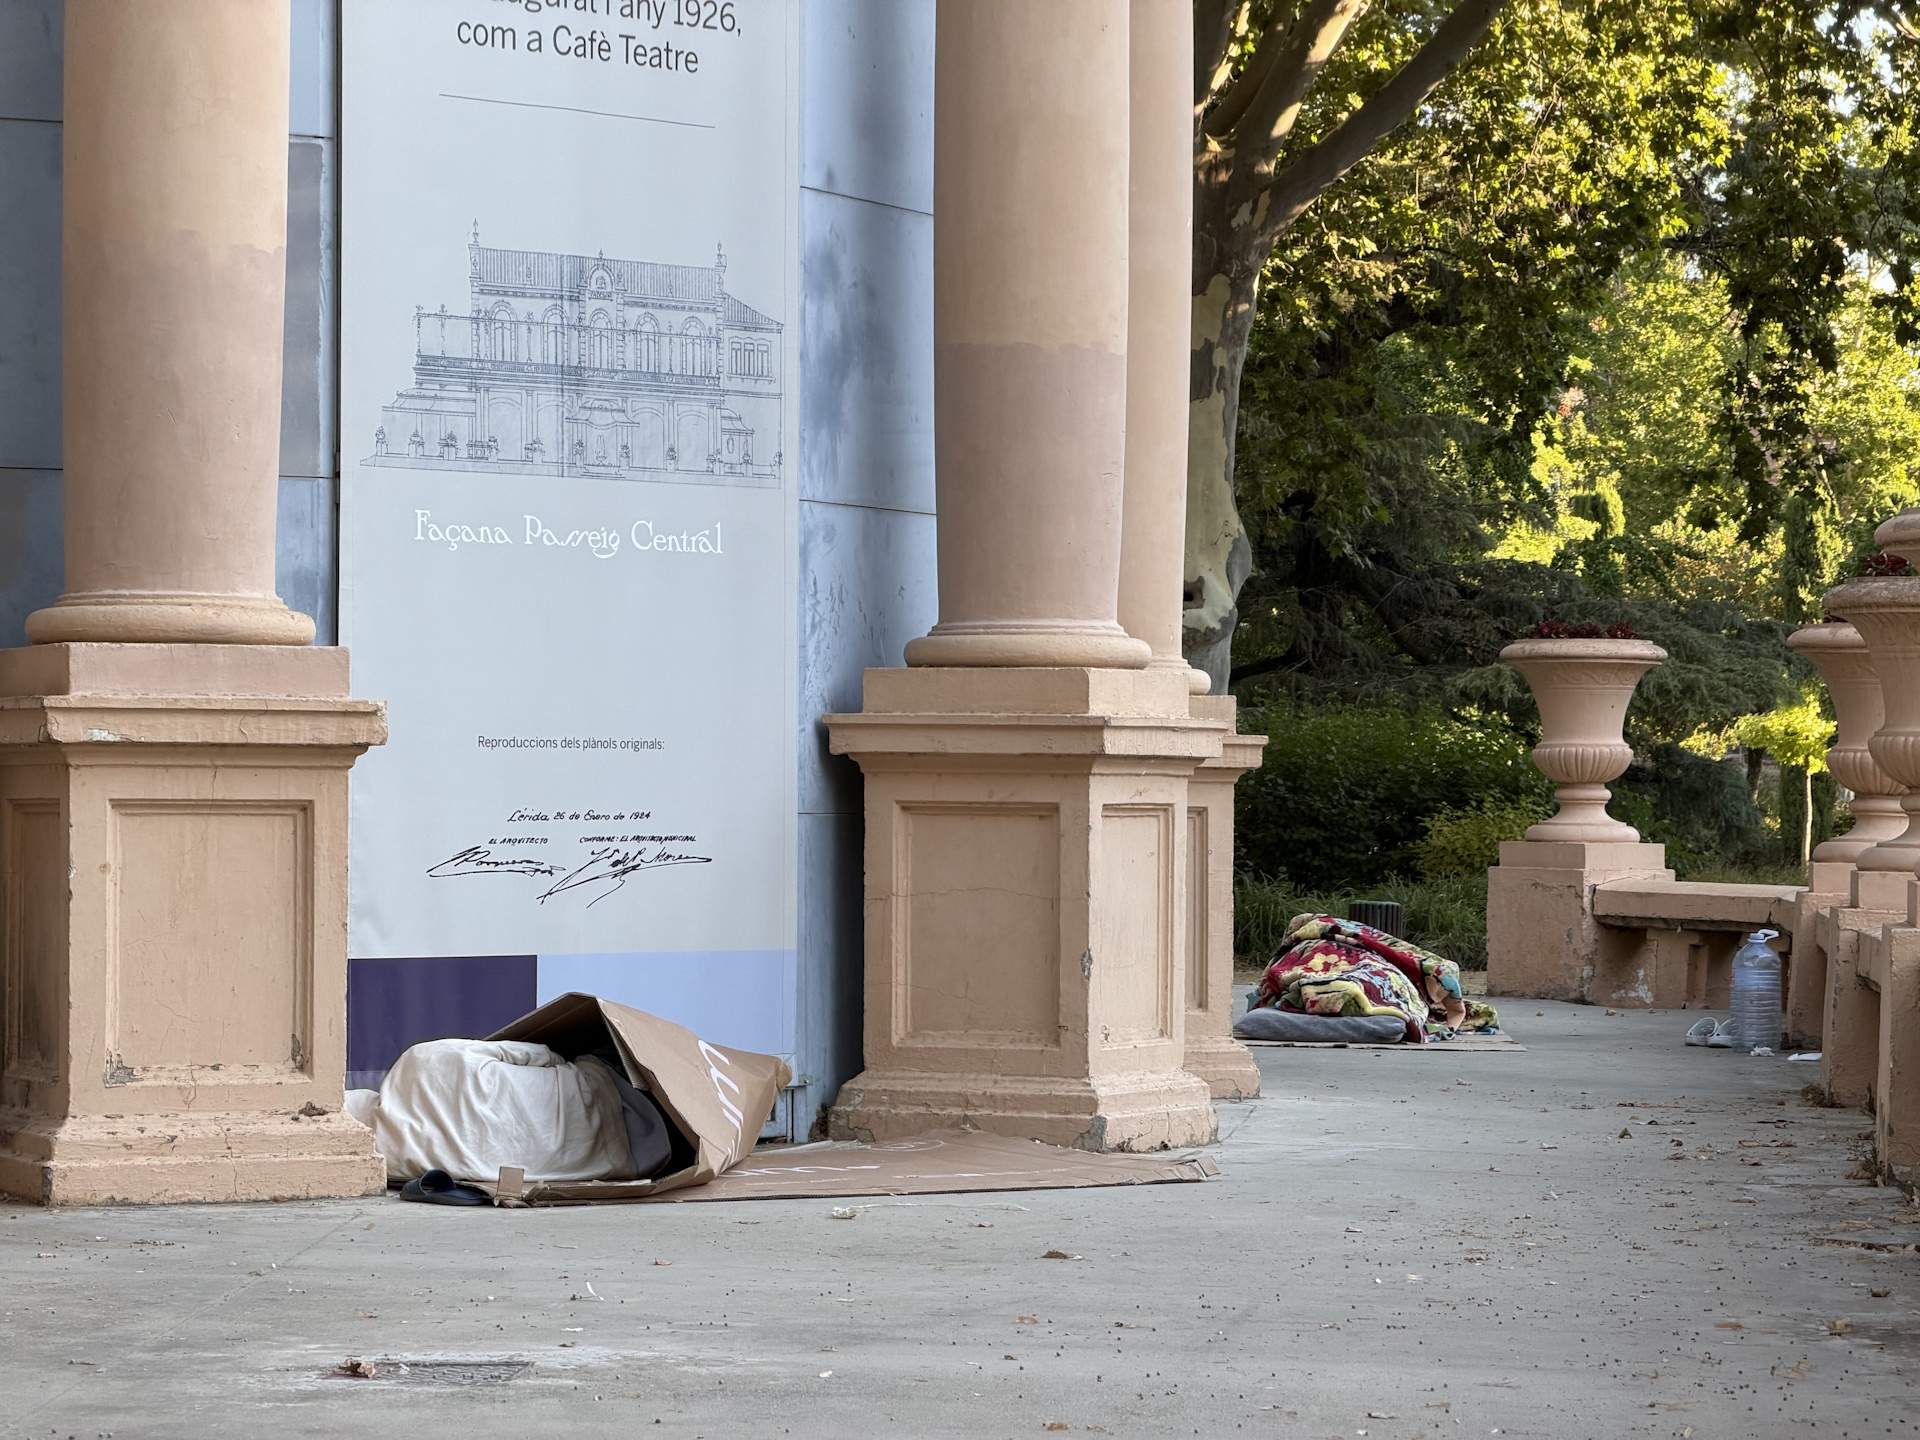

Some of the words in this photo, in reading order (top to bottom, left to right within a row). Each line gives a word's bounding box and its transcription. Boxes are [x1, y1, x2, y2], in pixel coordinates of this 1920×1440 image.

[673, 0, 741, 38] 1926,
[457, 21, 516, 51] com
[526, 30, 543, 54] a
[552, 25, 612, 62] Cafè
[618, 33, 699, 74] Teatre
[413, 509, 513, 552] Façana
[523, 514, 621, 559] Passeig
[630, 519, 724, 555] Central
[477, 735, 558, 750] Reproduccions
[560, 736, 581, 750] dels
[582, 737, 618, 752] plànols
[619, 737, 665, 753] originals:
[553, 810, 565, 821] 26
[568, 810, 581, 821] de
[583, 809, 611, 821] Enero
[613, 811, 625, 821] de
[629, 811, 651, 820] 1924
